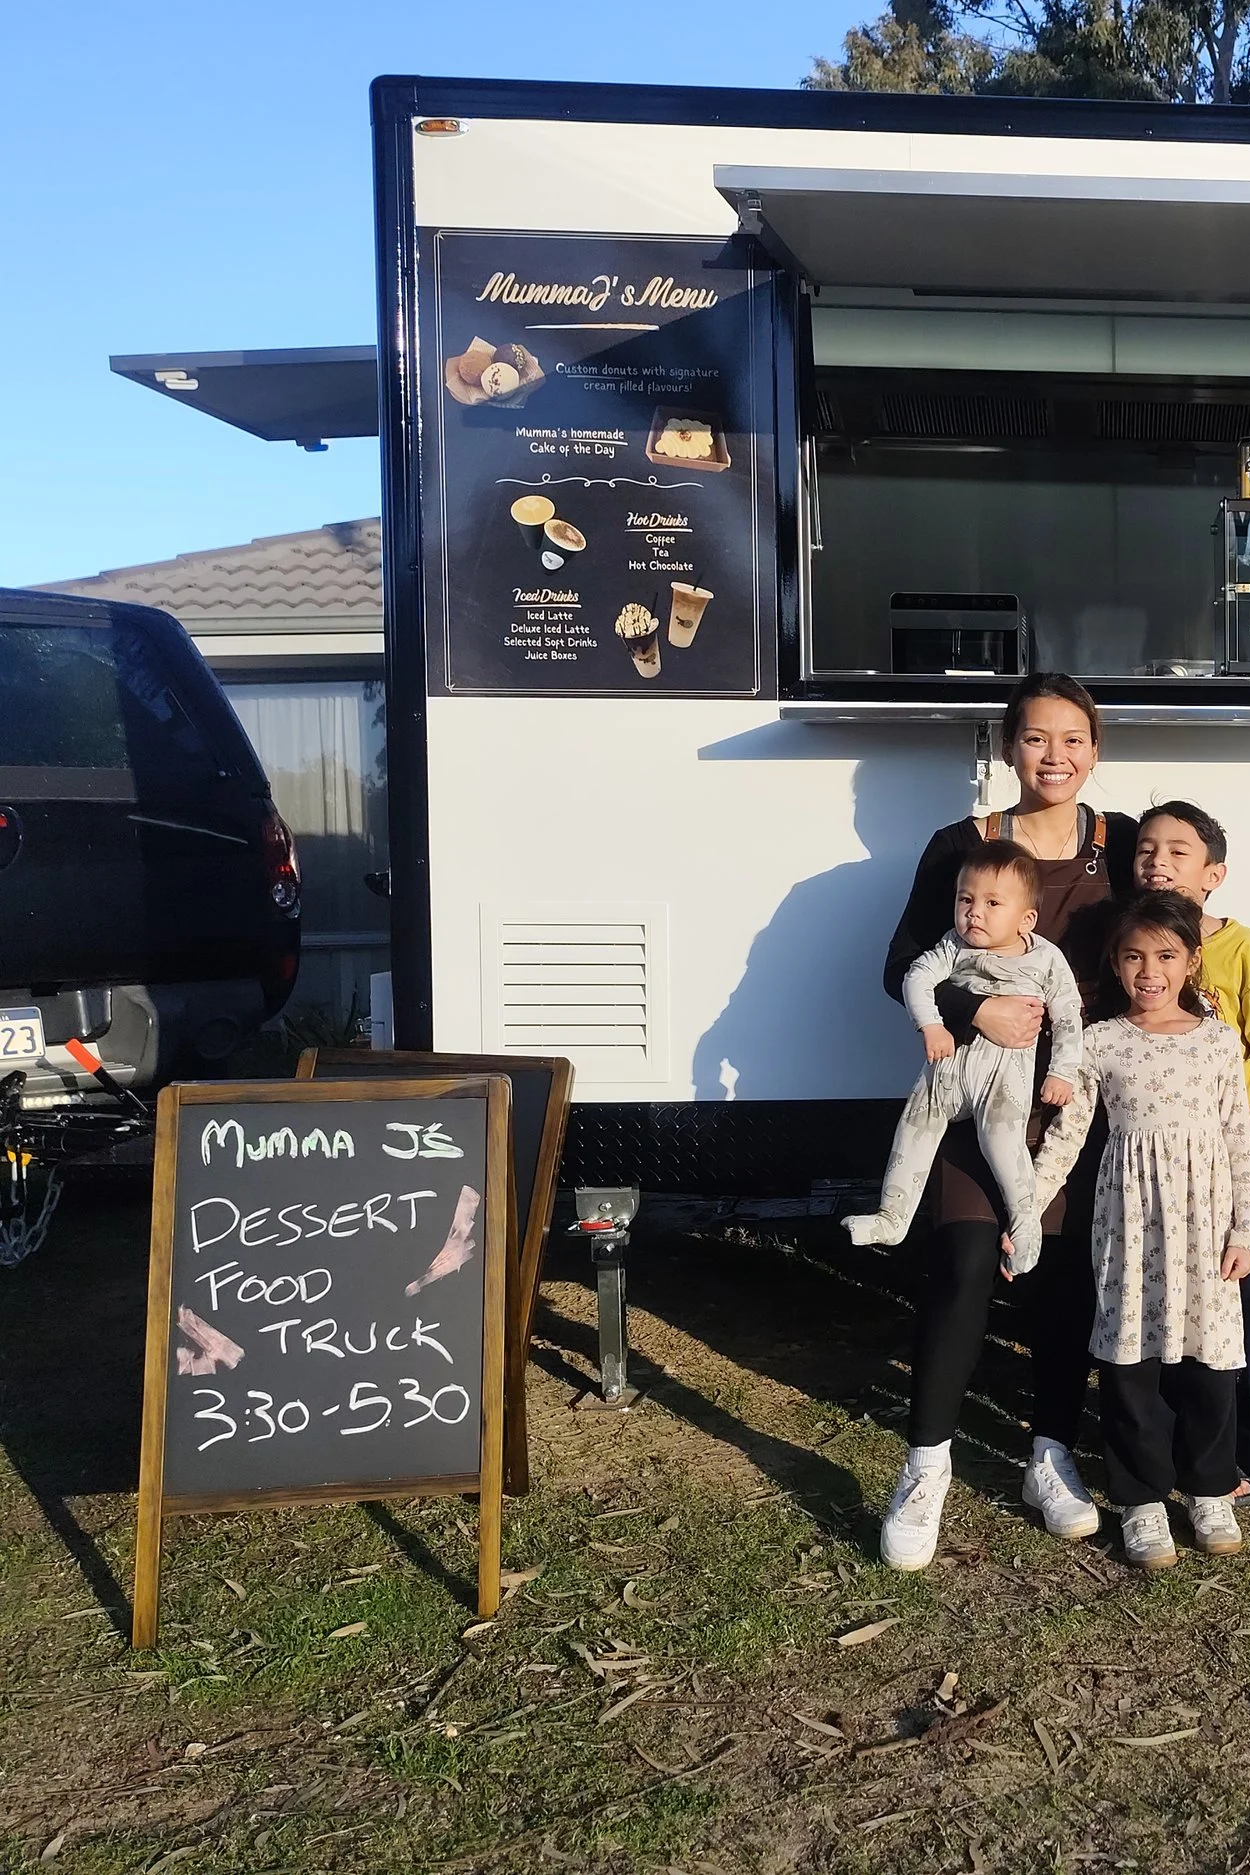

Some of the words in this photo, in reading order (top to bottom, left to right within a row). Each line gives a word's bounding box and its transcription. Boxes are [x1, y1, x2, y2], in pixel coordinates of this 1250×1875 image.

[635, 276, 718, 309] Menu
[555, 362, 598, 375] Custom
[602, 363, 638, 376] donuts
[642, 365, 666, 377] with
[669, 367, 719, 380] signature
[584, 380, 616, 391] cream
[619, 380, 644, 394] filled
[647, 382, 693, 394] flavours!
[516, 427, 567, 438] Mumma's
[570, 427, 625, 439] homemade
[529, 441, 556, 453] Cake
[559, 444, 570, 457] of
[573, 443, 591, 454] the
[594, 444, 615, 458] Day
[645, 533, 676, 547] Coffee
[652, 547, 669, 557] Tea
[628, 560, 647, 570] Hot
[649, 560, 694, 571] Chocolate
[527, 610, 545, 620] Iced
[547, 610, 574, 620] Latte
[511, 623, 541, 633] Deluxe
[544, 624, 562, 633] Iced
[564, 624, 590, 634] Latte
[503, 636, 542, 647] Selected
[544, 637, 565, 649] Soft
[567, 637, 598, 647] Drinks
[524, 650, 548, 660] Juice
[551, 651, 577, 660] Boxes
[0, 1026, 37, 1055] 23
[190, 1190, 438, 1254] DESSERT
[194, 1260, 332, 1311] FOOD
[258, 1316, 453, 1364] TRUCK
